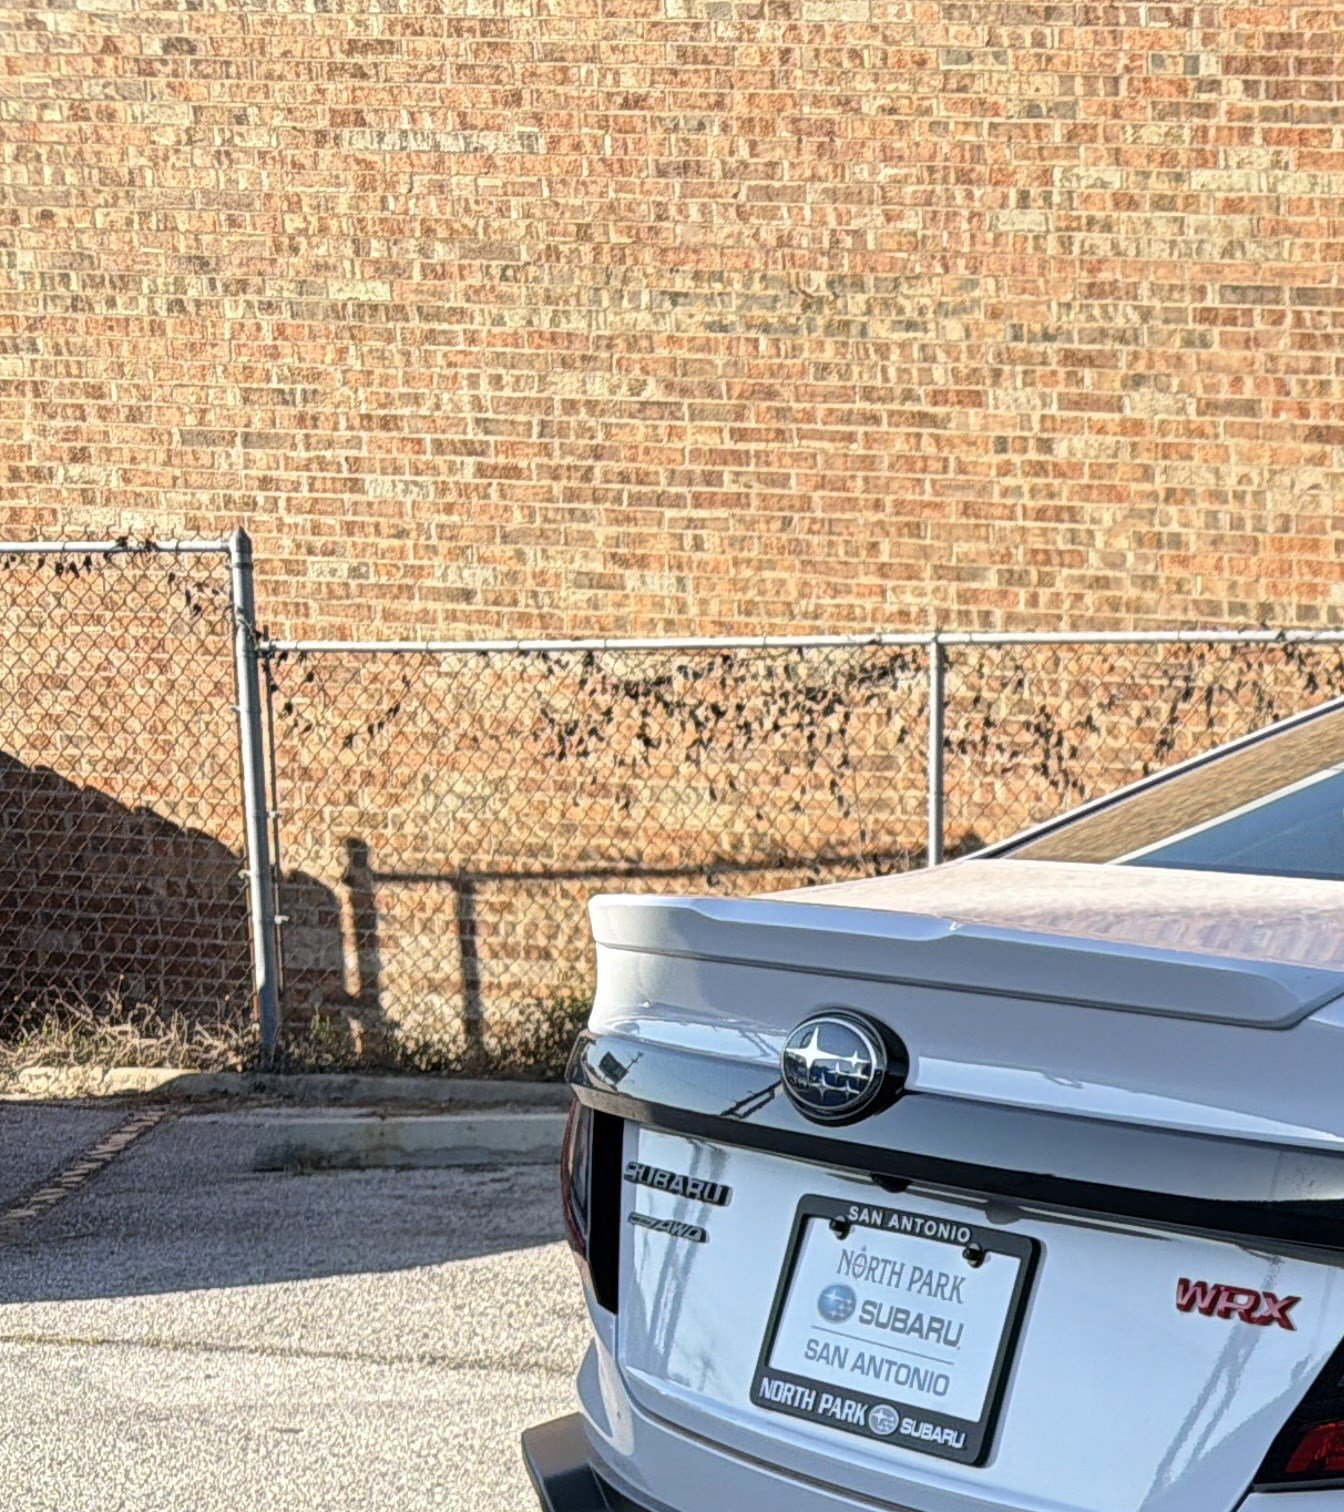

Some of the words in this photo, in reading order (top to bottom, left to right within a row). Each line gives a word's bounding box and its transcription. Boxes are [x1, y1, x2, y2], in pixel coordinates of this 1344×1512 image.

[624, 1161, 733, 1207] SUBARU
[849, 1205, 883, 1225] SAN
[888, 1211, 971, 1243] ANTONIO
[836, 1247, 905, 1288] NORTH
[908, 1266, 966, 1304] PARK
[858, 1300, 964, 1347] SUBARU
[1176, 1277, 1301, 1331] WRX
[804, 1338, 850, 1369] SAN
[850, 1353, 950, 1397] ANTONIO
[759, 1377, 816, 1411] NORTH
[818, 1394, 868, 1426] PARK
[900, 1418, 966, 1448] SUBARU
